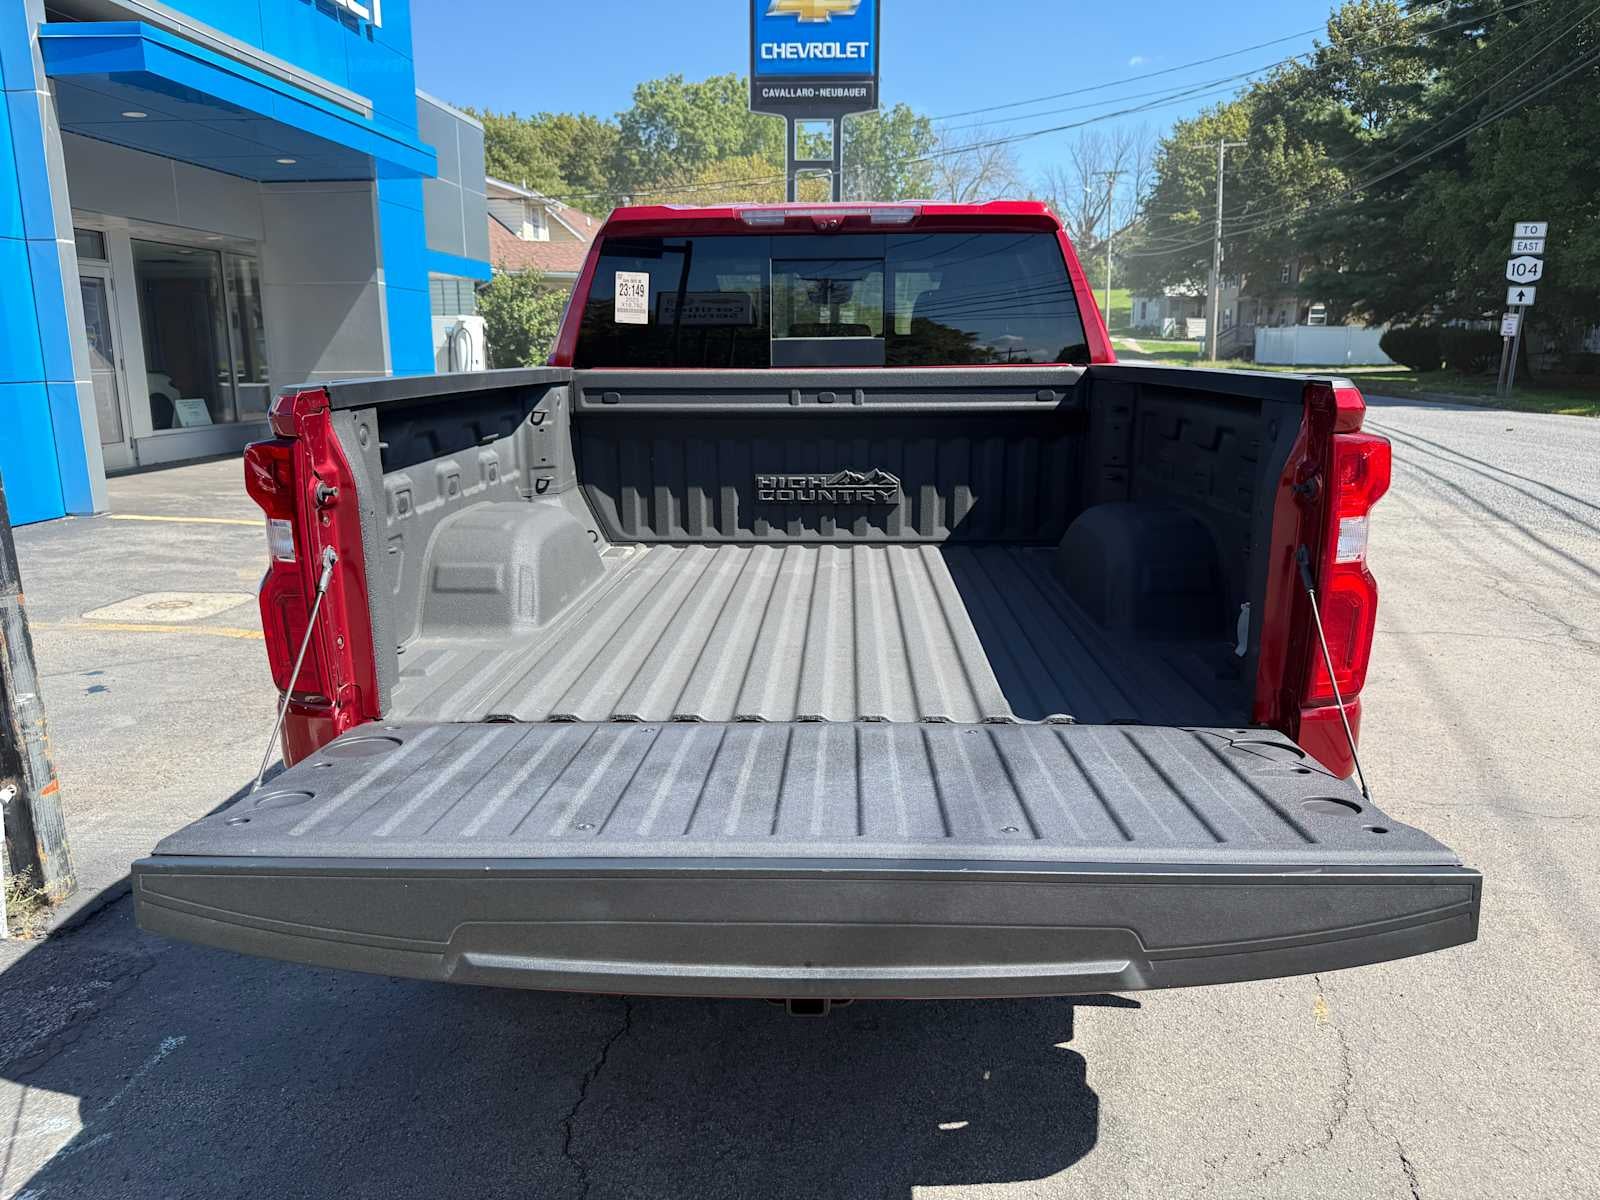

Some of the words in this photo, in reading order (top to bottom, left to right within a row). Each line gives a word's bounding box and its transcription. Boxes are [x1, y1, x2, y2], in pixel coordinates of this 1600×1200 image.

[761, 42, 869, 59] CHEVROLET
[1522, 225, 1538, 235] TO
[1517, 241, 1539, 251] EAST
[1511, 263, 1538, 277] 104
[757, 476, 827, 488] HIGH
[758, 489, 897, 504] COUNTRY
